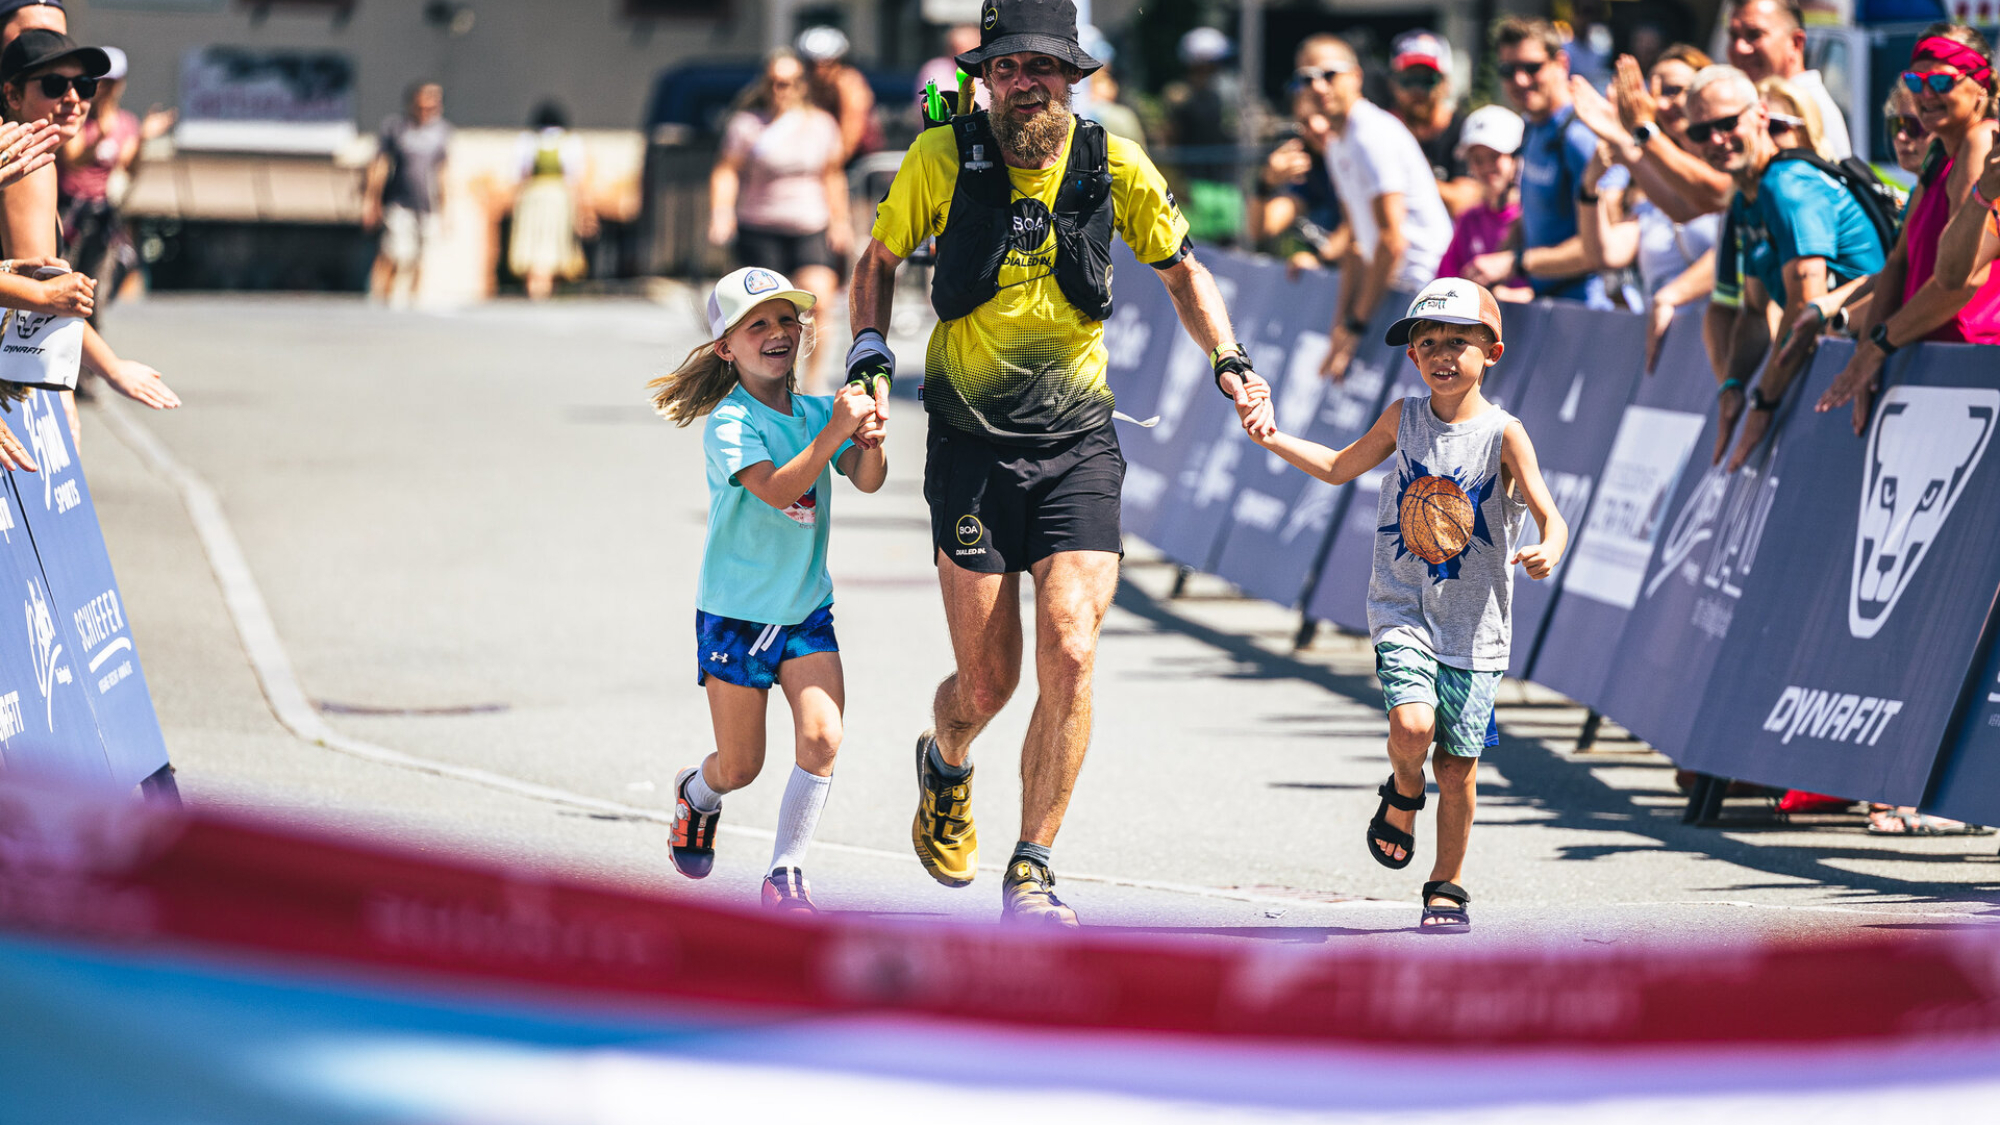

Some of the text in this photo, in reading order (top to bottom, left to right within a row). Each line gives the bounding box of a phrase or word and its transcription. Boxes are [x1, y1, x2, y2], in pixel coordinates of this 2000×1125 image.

[1012, 215, 1044, 231] BOA
[1003, 256, 1039, 267] DIALED
[3, 344, 46, 355] DYNAFIT
[54, 478, 81, 514] SPORTS
[73, 589, 124, 653] SCHIEFER
[1763, 685, 1904, 746] DYNAFIT
